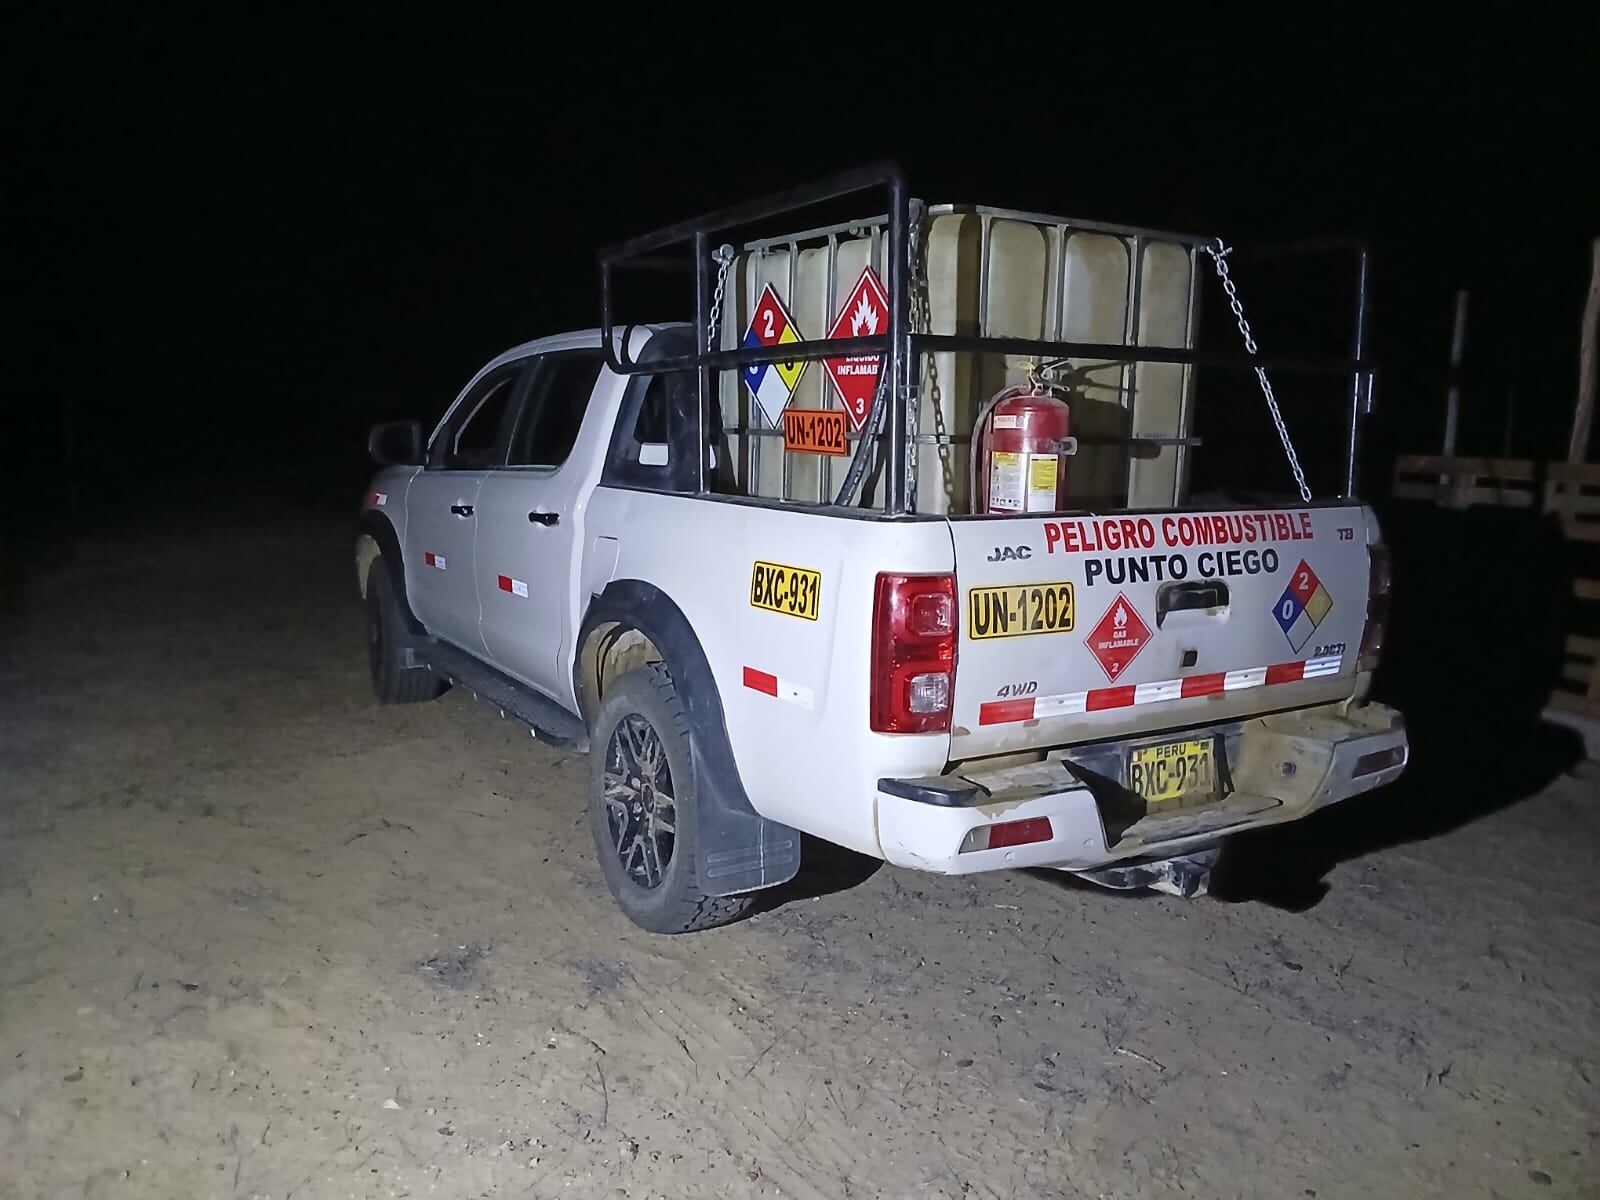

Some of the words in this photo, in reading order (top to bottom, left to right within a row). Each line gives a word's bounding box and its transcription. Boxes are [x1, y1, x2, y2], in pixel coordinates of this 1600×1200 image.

[763, 309, 775, 338] 2
[837, 364, 880, 375] INFLAMAB
[855, 397, 865, 415] 3
[786, 415, 842, 448] UN-1202
[1044, 518, 1155, 554] PELIGRO
[1161, 512, 1314, 547] COMBUSTIBLE
[987, 546, 1032, 562] JAC
[1084, 554, 1188, 586] PUNTO
[1197, 548, 1279, 578] CIEGO
[1299, 572, 1309, 590] 2
[753, 566, 818, 617] BXC-931
[973, 587, 1071, 635] UN-1202
[1282, 599, 1294, 620] 0
[1113, 630, 1127, 639] GAS
[1111, 662, 1119, 673] 2
[996, 681, 1038, 697] 4WD
[1156, 743, 1187, 759] PERU
[1131, 752, 1211, 797] BXC-931
